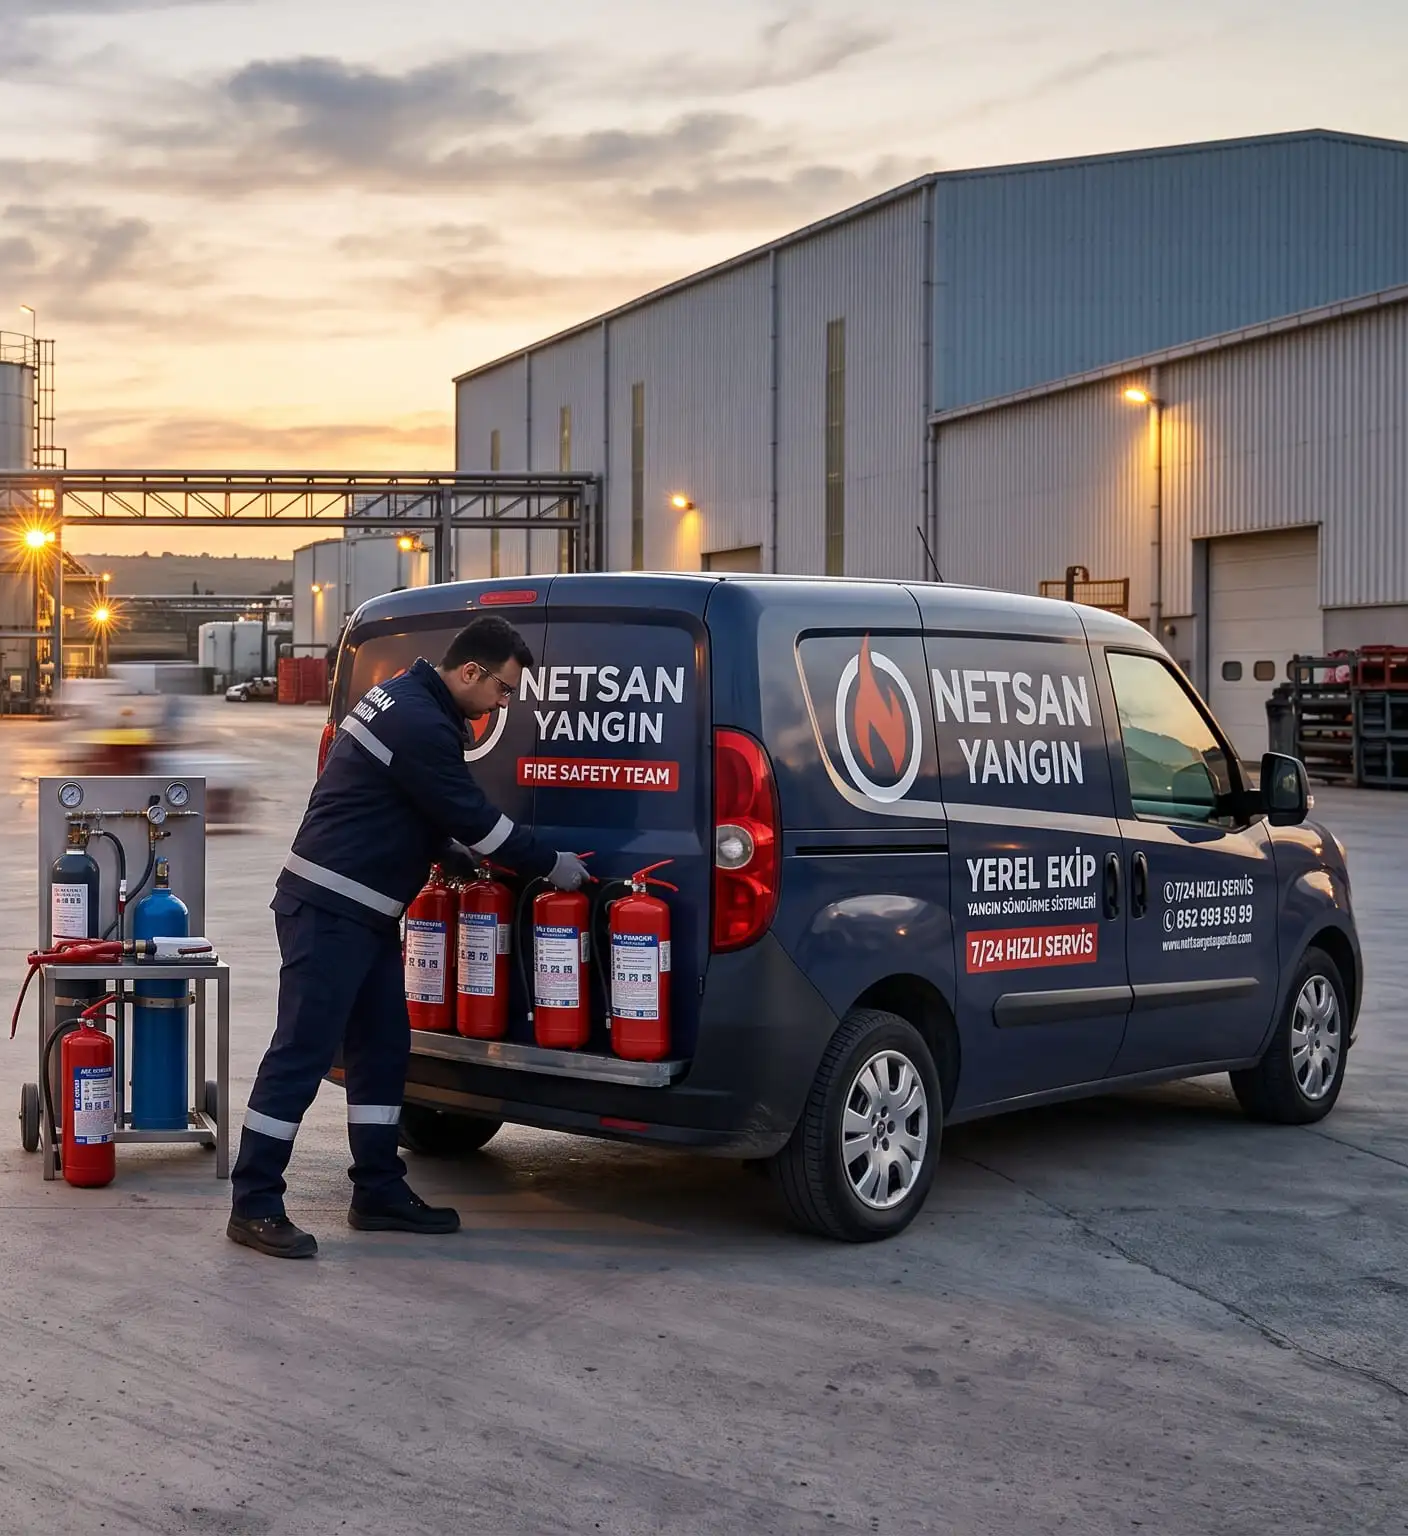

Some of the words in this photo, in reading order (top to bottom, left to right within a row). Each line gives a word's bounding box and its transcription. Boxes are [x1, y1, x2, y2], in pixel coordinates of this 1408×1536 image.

[519, 665, 685, 703] NETSAN
[931, 668, 1092, 727] NETSAN
[533, 710, 664, 743] YANGIN
[523, 763, 557, 780] FIRE
[560, 764, 621, 783] SAFETY
[624, 767, 670, 785] TEAM
[957, 738, 1084, 784] YANGIN
[966, 856, 1041, 892] YEREL
[1047, 846, 1097, 889] EKİP
[967, 901, 1001, 916] YANGIN
[1051, 892, 1096, 911] SİSTEMLERİ
[1174, 881, 1195, 903] 7/24
[1221, 873, 1254, 897] SERVİS
[1176, 908, 1198, 929] 852
[971, 939, 1004, 967] 7/24
[1006, 936, 1043, 960] HIZLI
[1045, 927, 1093, 957] SERVİS
